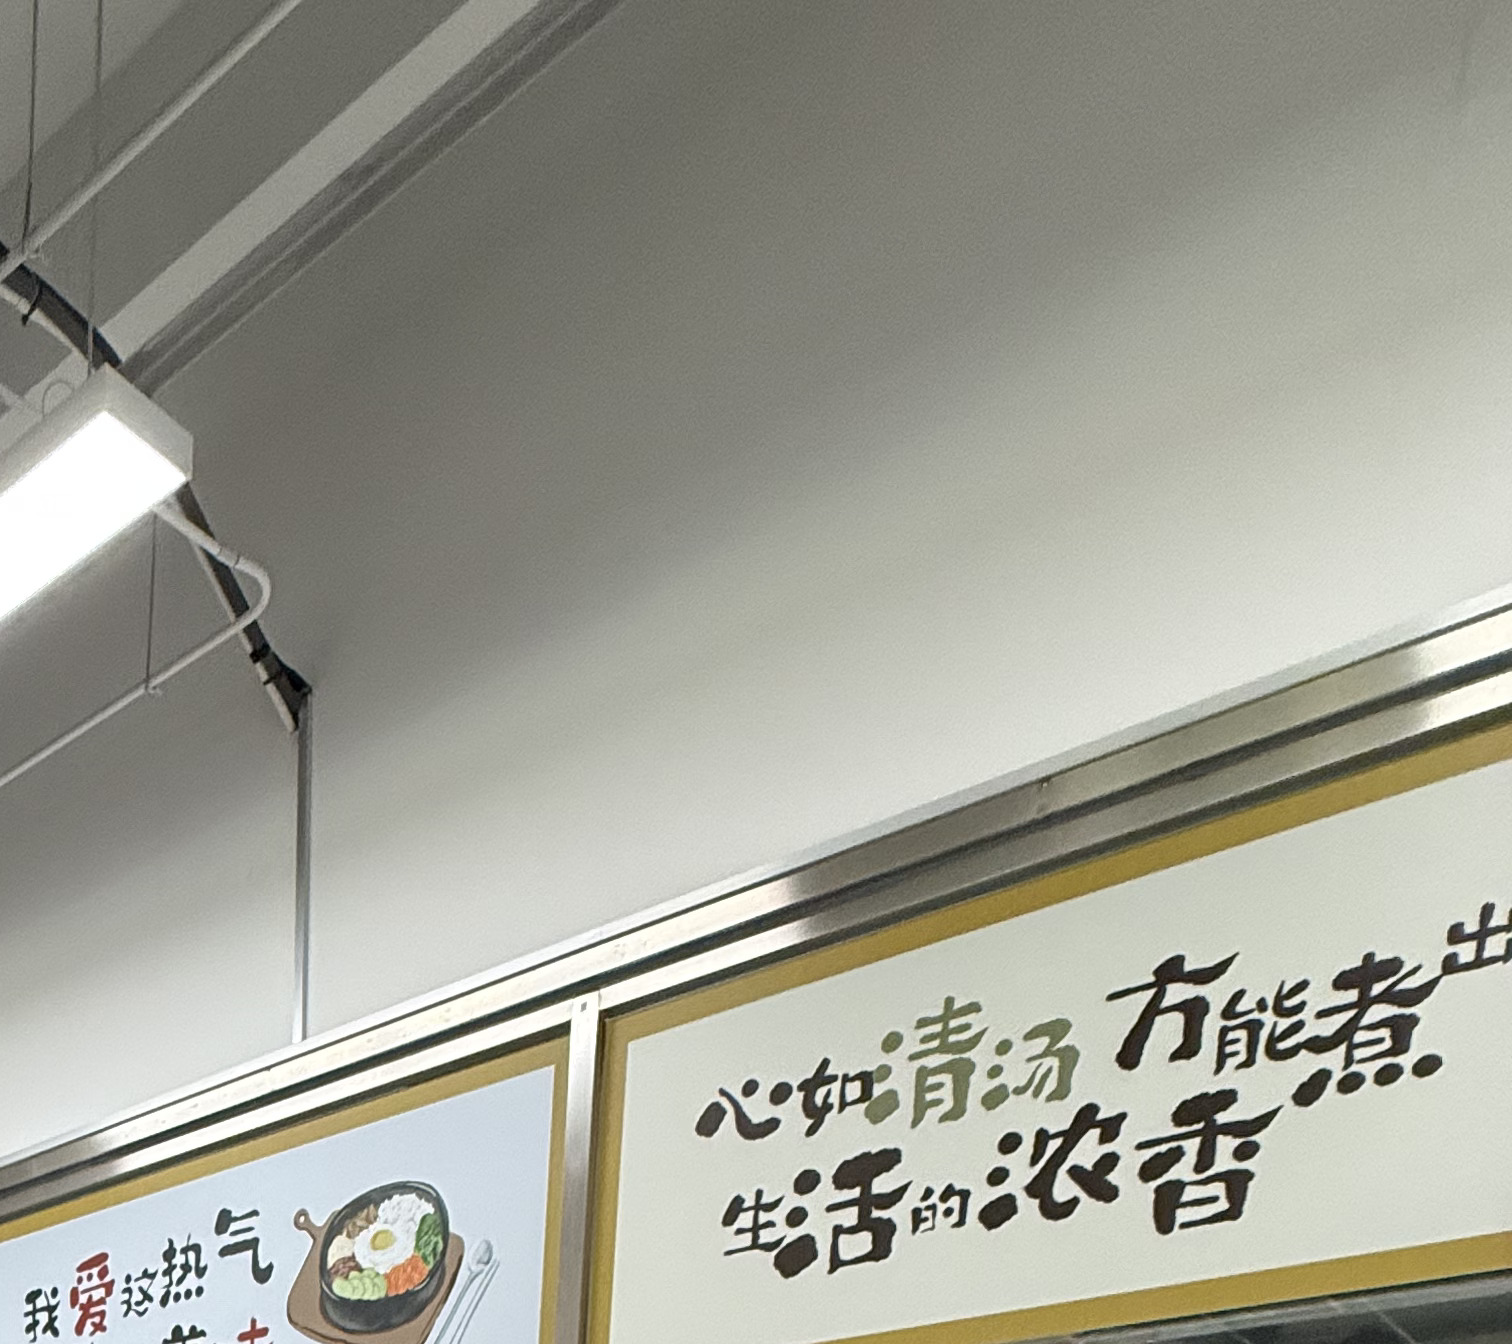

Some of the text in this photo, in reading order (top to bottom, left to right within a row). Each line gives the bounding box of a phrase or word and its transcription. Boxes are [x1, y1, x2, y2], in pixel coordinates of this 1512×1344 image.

[721, 1089, 1283, 1278] 生活的浓香
[23, 1208, 274, 1343] 我爱这热气
